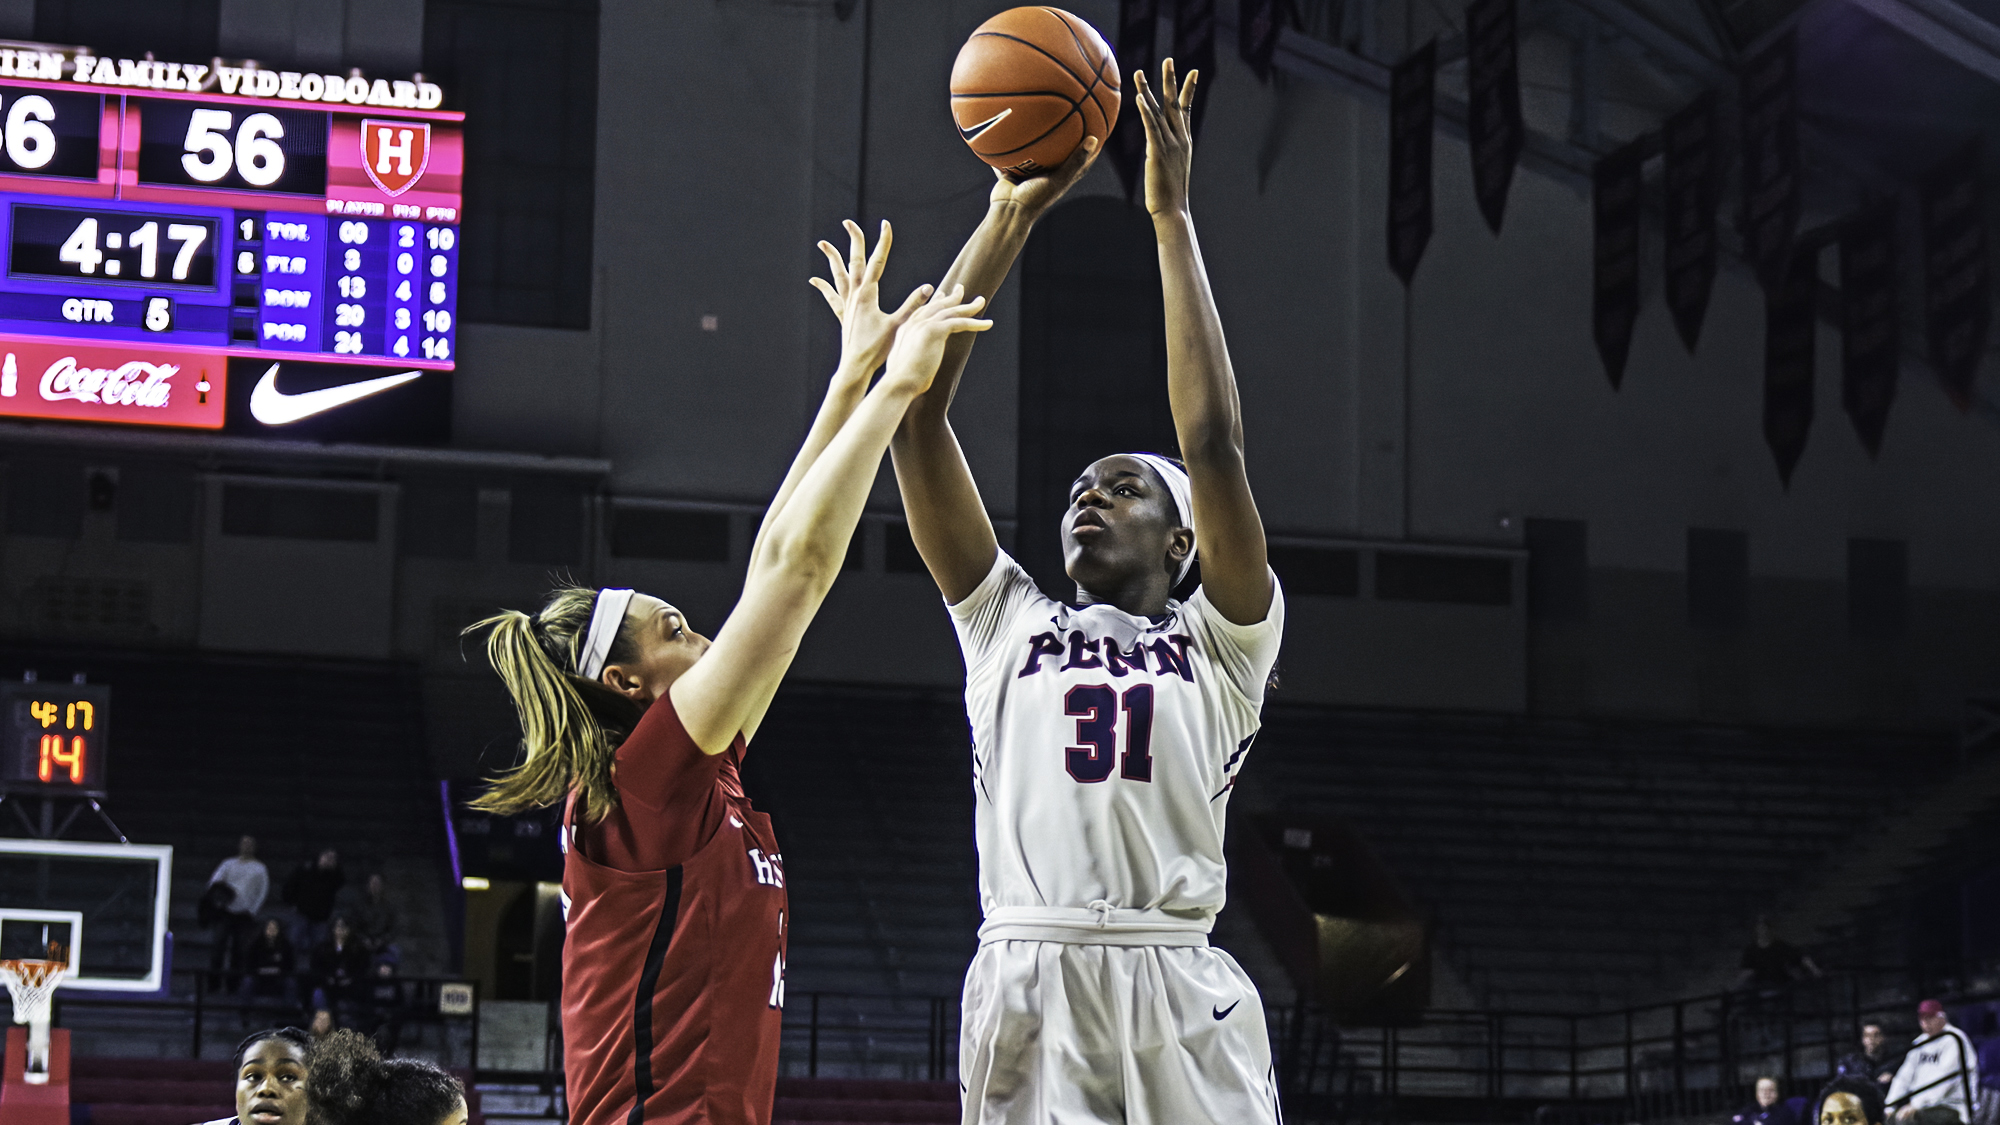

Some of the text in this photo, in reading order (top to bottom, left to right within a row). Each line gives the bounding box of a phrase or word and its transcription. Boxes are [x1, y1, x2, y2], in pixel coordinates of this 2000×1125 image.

[72, 55, 208, 92] FAMILY
[217, 66, 443, 109] VIDEOBOARD
[0, 94, 56, 169] 6
[181, 108, 285, 186] 56
[376, 127, 414, 176] H
[59, 217, 208, 280] 4:17
[240, 218, 254, 241] 1
[398, 225, 415, 248] 2
[426, 227, 454, 251] 10
[61, 297, 170, 332] QTR 5
[394, 279, 412, 302] 4
[335, 303, 366, 327] 20
[422, 309, 452, 333] 10
[333, 330, 450, 360] 24 4 14
[1017, 629, 1195, 684] PENN
[30, 700, 94, 731] 4:17
[1063, 682, 1154, 784] 31
[38, 733, 85, 784] 14
